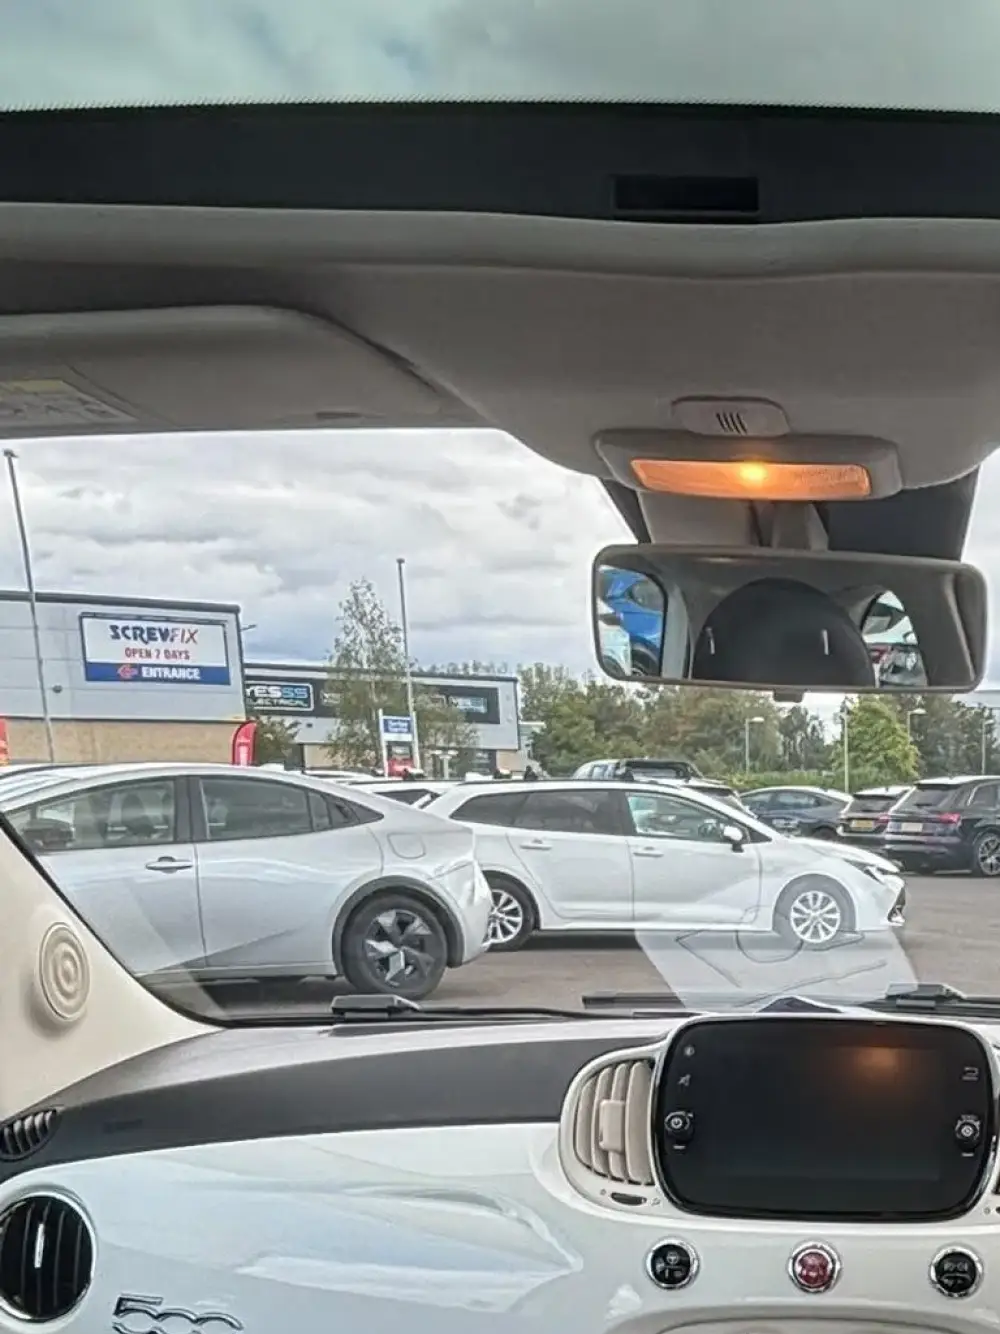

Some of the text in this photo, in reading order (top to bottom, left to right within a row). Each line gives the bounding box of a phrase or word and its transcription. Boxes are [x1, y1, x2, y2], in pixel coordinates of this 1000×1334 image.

[109, 624, 198, 645] SCREWFIX
[124, 647, 152, 659] OPEN
[163, 649, 190, 660] DAYS
[142, 666, 201, 680] ENTRANCE
